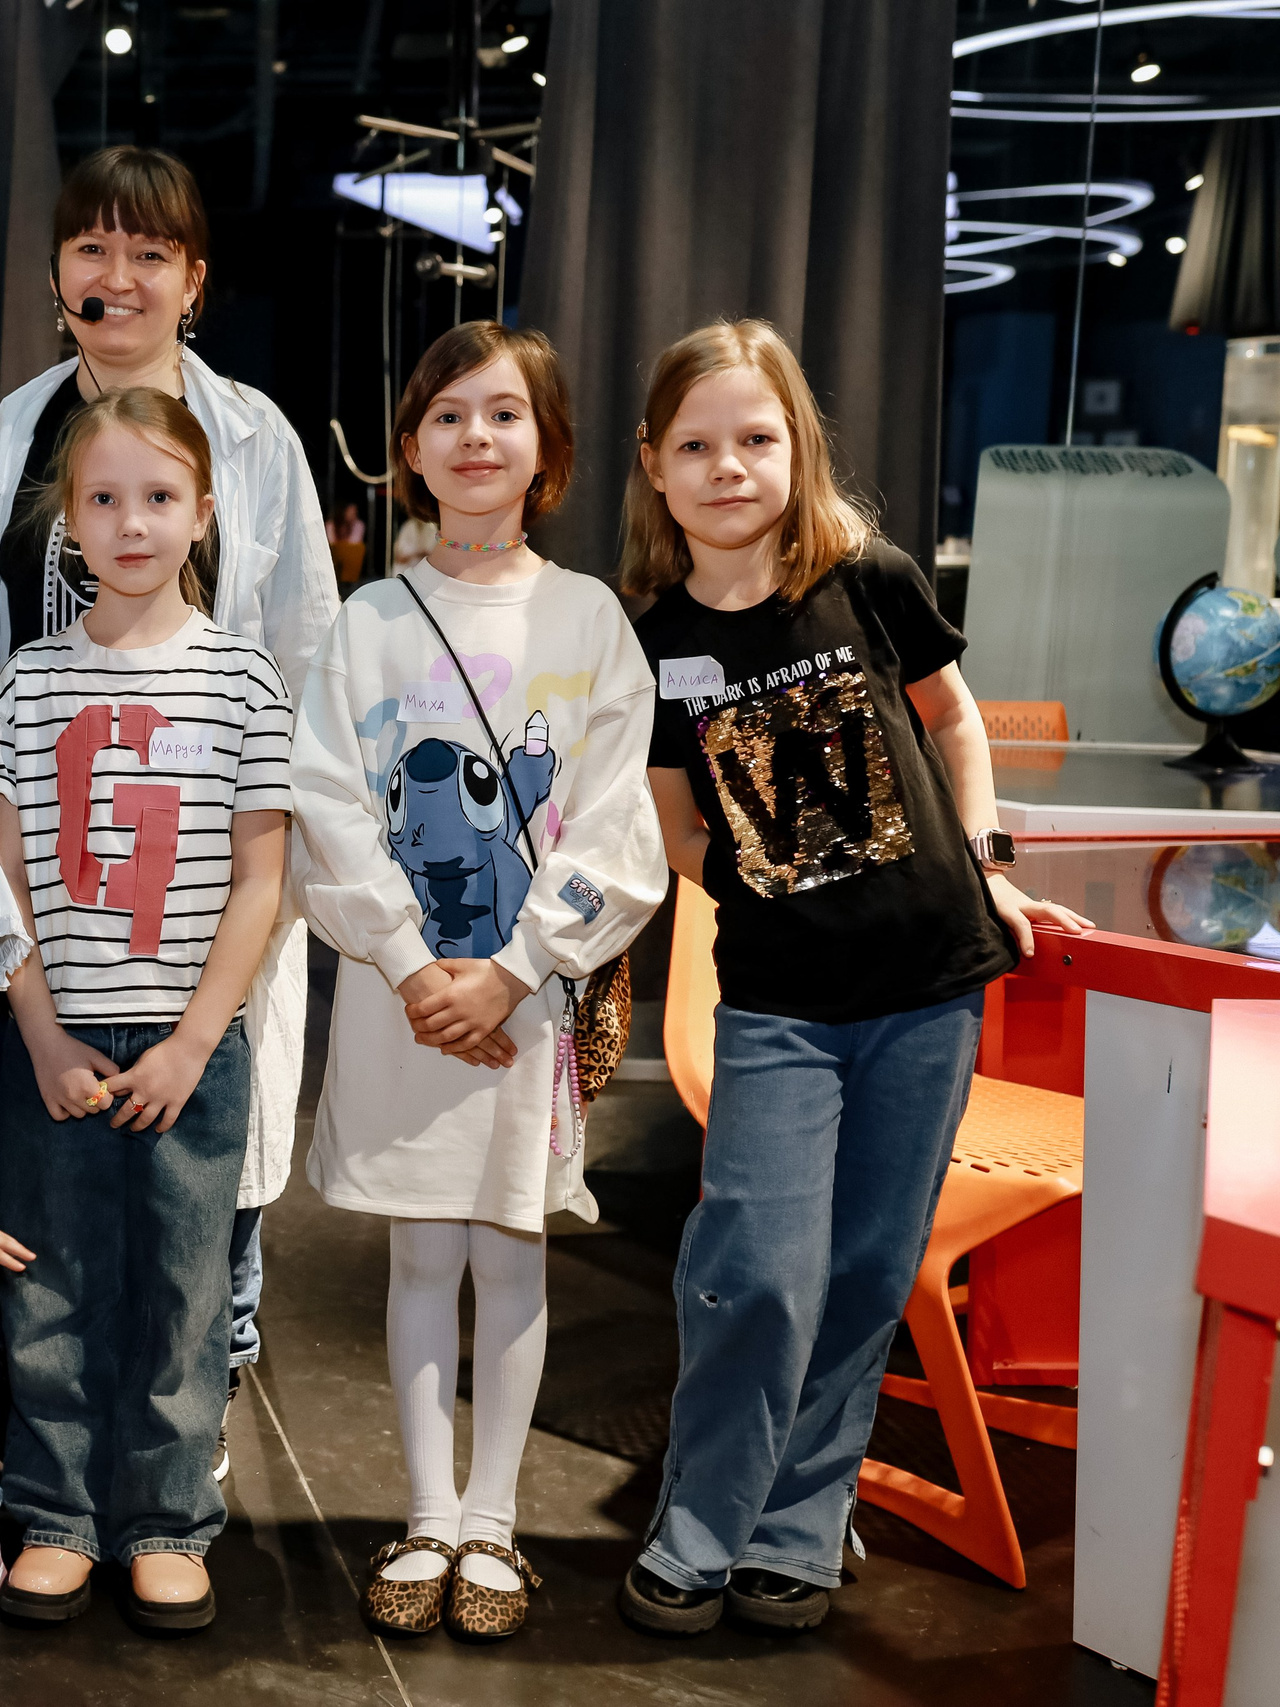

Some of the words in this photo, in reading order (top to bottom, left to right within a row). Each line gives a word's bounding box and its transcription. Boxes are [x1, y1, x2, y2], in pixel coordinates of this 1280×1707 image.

[666, 671, 719, 689] Алиса
[683, 697, 710, 717] THE
[713, 682, 746, 707] DARK
[747, 676, 762, 695] IS
[766, 659, 813, 690] AFRAID
[814, 651, 832, 671] OF
[835, 645, 856, 664] ME
[404, 694, 445, 713] Миха
[150, 740, 203, 760] Маруся
